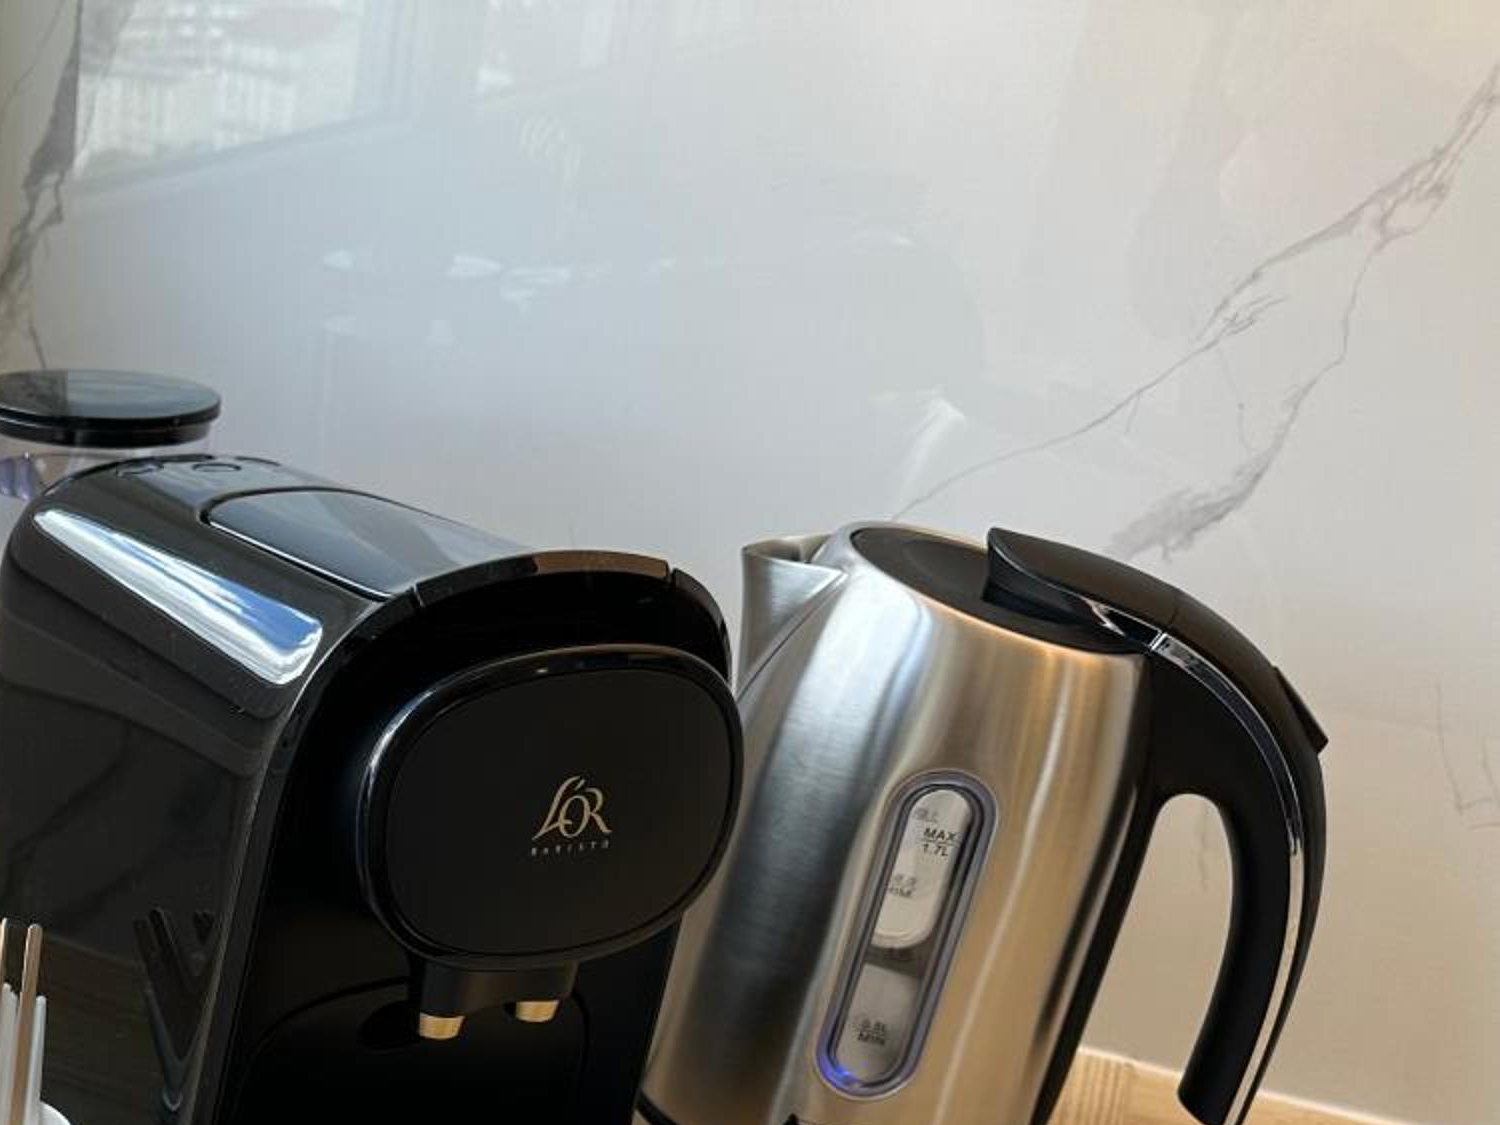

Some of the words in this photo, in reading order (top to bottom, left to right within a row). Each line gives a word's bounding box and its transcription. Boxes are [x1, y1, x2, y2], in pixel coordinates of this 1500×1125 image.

[531, 775, 612, 841] L'OR
[923, 827, 958, 841] MAX
[922, 842, 949, 857] 1.7L
